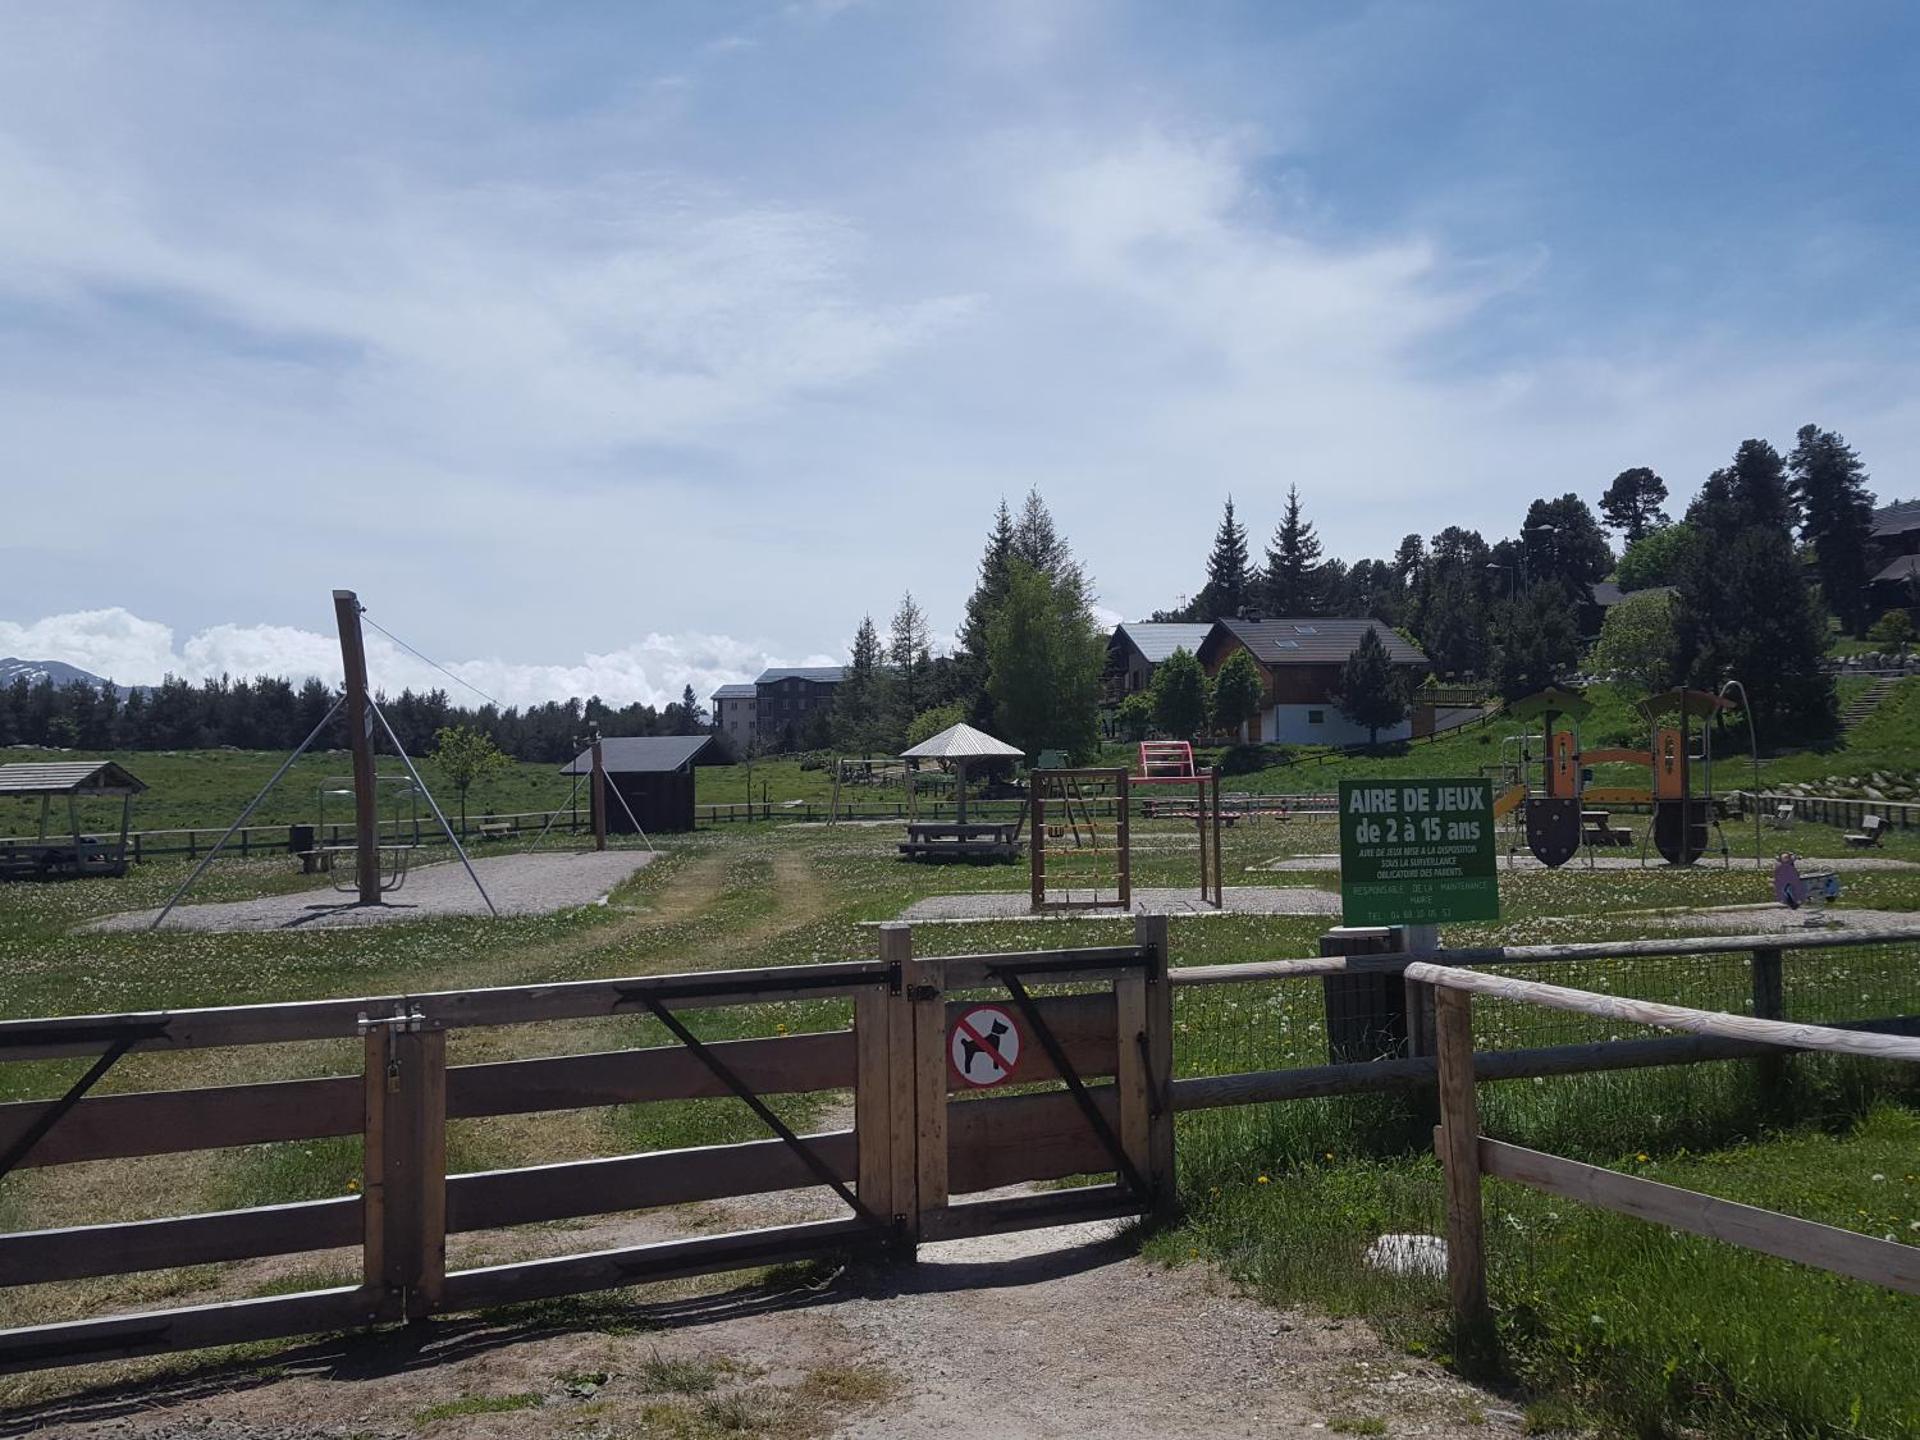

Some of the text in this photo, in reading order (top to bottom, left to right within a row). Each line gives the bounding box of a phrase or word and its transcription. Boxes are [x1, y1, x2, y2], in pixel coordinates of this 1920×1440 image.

[1349, 786, 1485, 813] AIRE DE JEUX
[1356, 816, 1481, 843] de 2 à 15 ans
[1376, 848, 1385, 857] DE
[1427, 846, 1436, 855] LA
[1437, 845, 1477, 854] DISPOSITION
[1400, 858, 1408, 867] LA
[1410, 857, 1457, 866] SURVEILLANCE
[1419, 868, 1432, 877] DES
